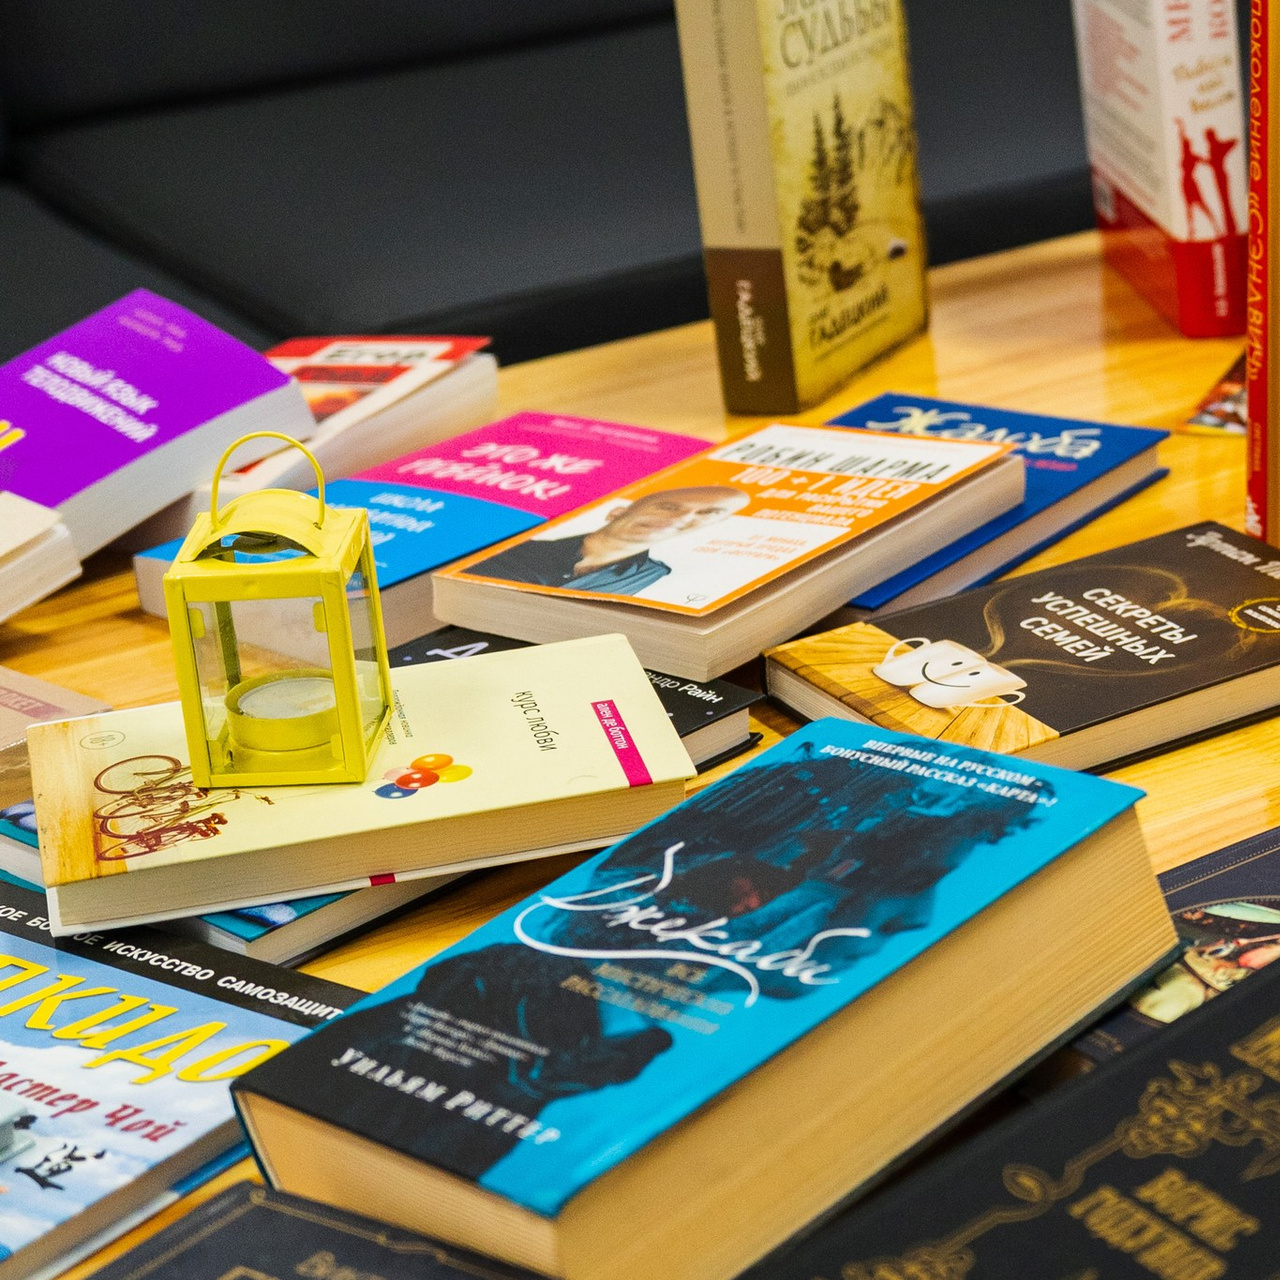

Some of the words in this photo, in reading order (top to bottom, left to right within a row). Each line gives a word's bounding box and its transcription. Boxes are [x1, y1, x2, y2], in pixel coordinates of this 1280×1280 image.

[719, 441, 834, 468] РОБИН
[828, 454, 951, 482] ШАРМА
[729, 466, 793, 487] 100
[1018, 616, 1114, 663] СЕМЕЙ
[1030, 591, 1176, 666] УСПЕШНЫХ
[1082, 587, 1199, 645] СЕКРЕТЫ
[510, 689, 541, 717] курс
[677, 682, 725, 705] Райн
[525, 714, 560, 753] любви
[596, 702, 614, 721] ален
[609, 724, 630, 751] боттон
[819, 743, 911, 772] БОНУСНЫЙ
[905, 762, 978, 788] РАССКАЗ
[861, 738, 939, 764] ВПЕРВЫЕ
[933, 753, 958, 769] НА
[956, 760, 1037, 788] РУССКОМ
[513, 840, 873, 1009] Джекаби
[26, 914, 104, 947] БООЕ
[102, 940, 215, 981] ИСКУССТВО
[216, 974, 346, 1021] САМОЗАЩИТ
[0, 1059, 100, 1119] астер
[104, 1103, 189, 1143] Цой
[330, 1046, 447, 1116] Уильям
[442, 1090, 561, 1145] Риттер
